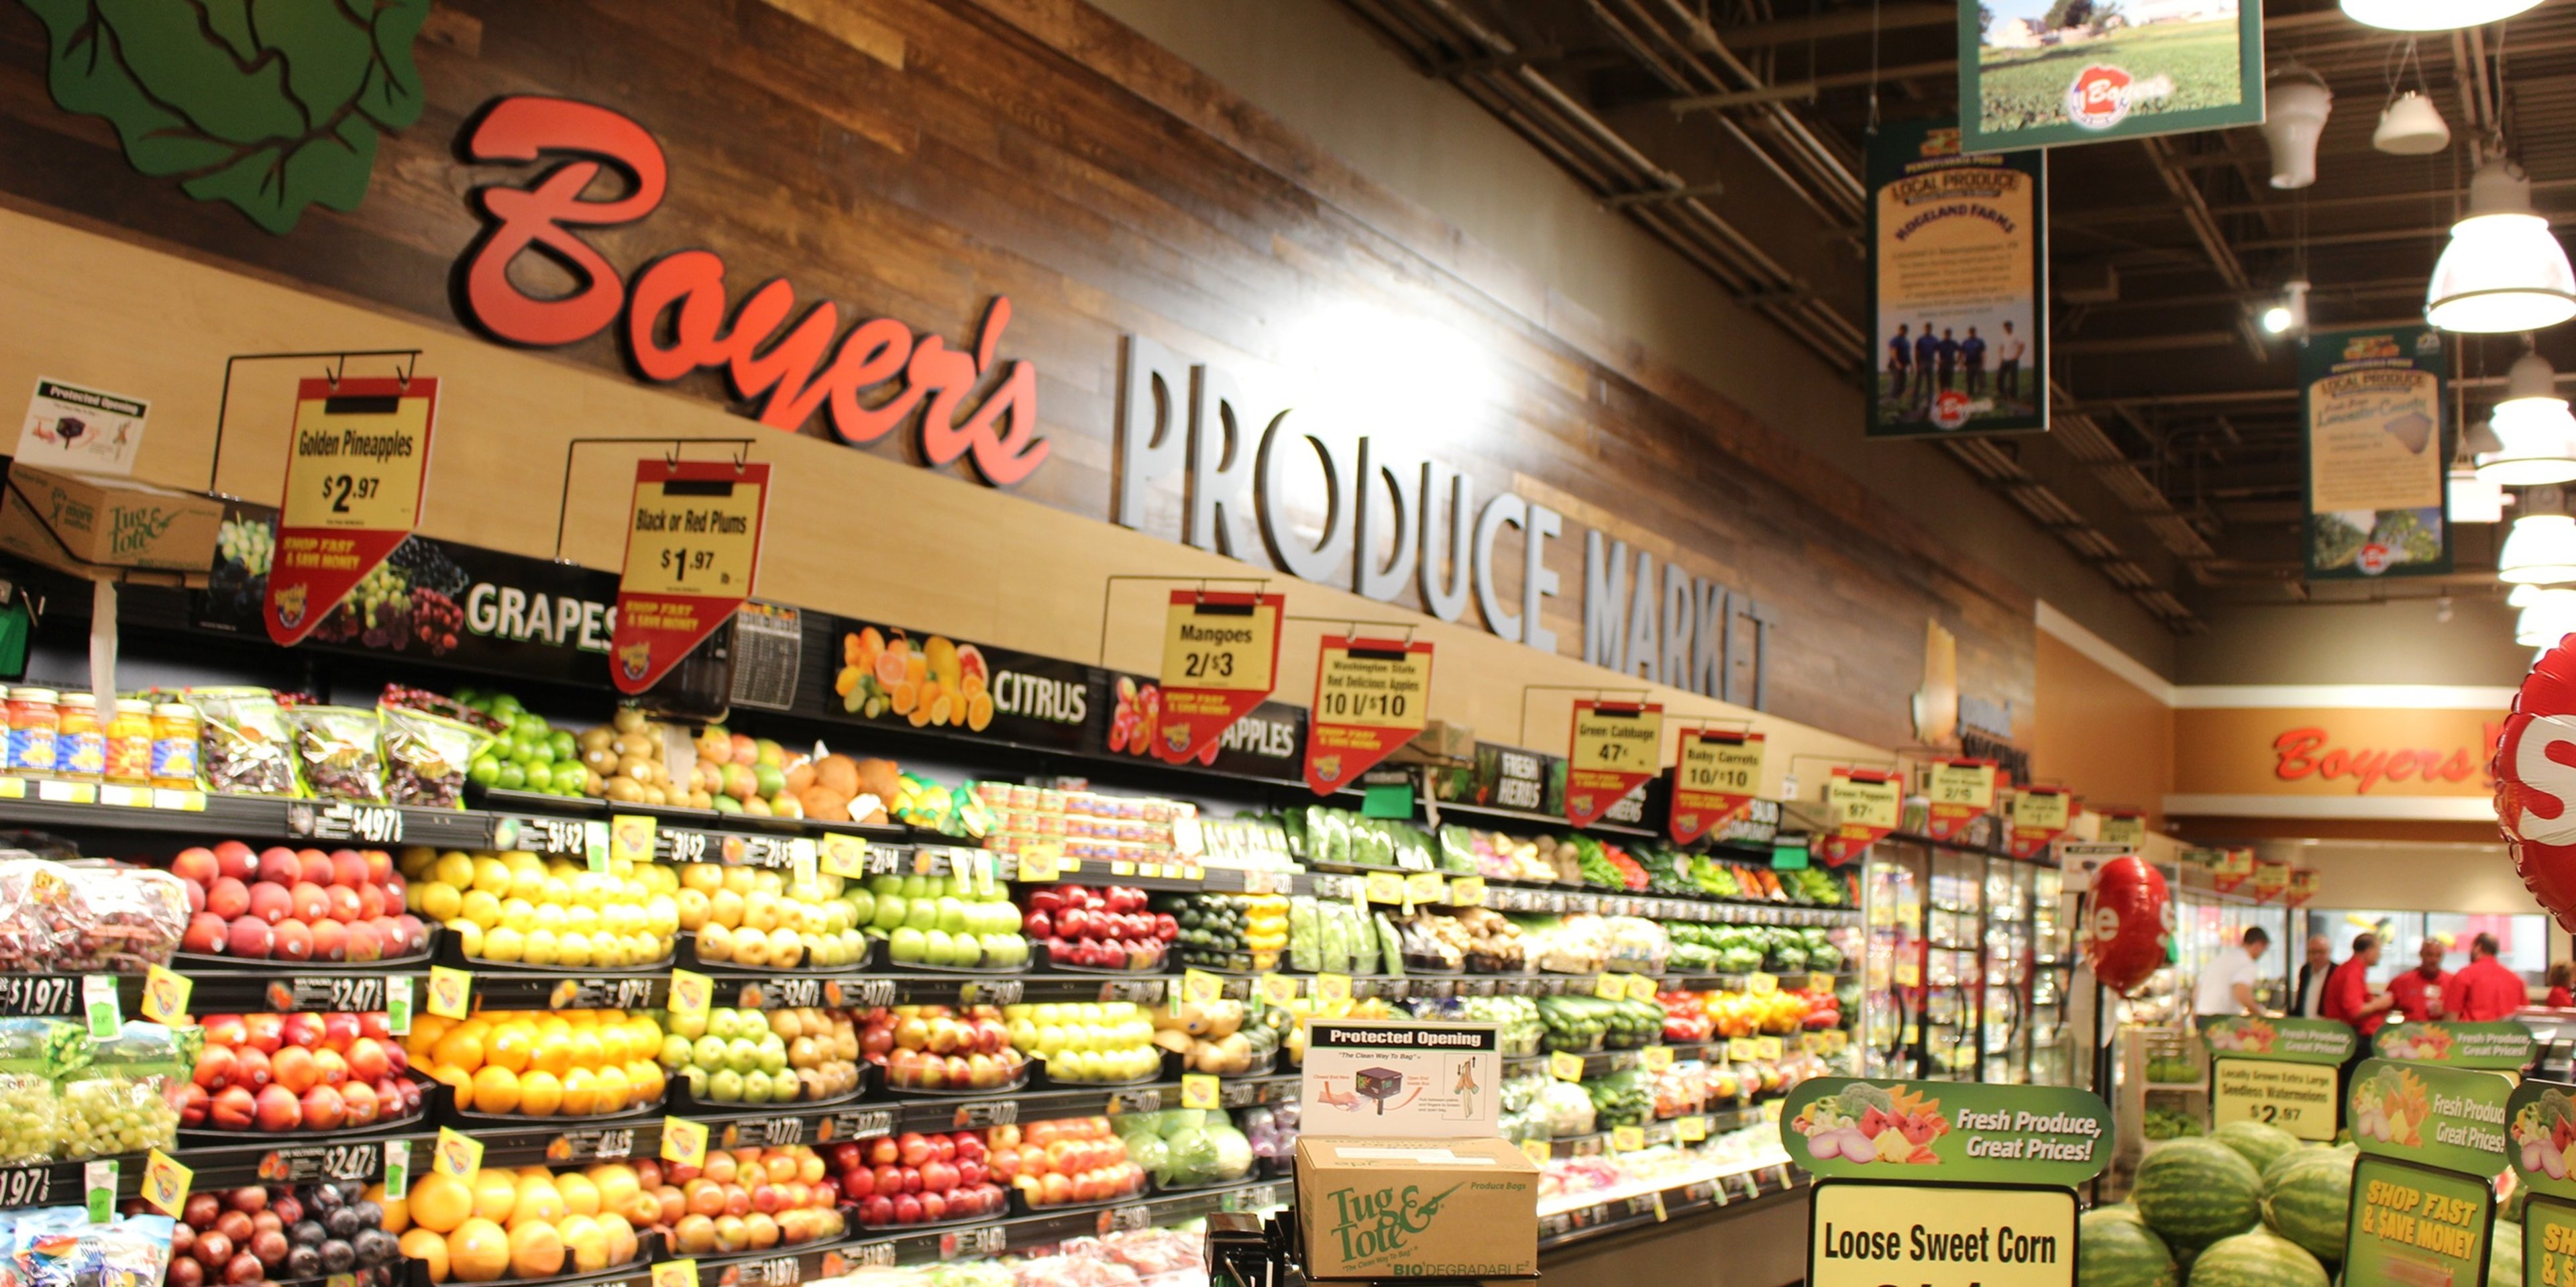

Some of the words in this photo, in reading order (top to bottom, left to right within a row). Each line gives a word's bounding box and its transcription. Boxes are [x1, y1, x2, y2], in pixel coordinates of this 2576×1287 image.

[1892, 176, 1937, 200] LOCAL
[1943, 170, 2019, 191] PRODUCE
[1970, 203, 2015, 234] FARMS
[462, 95, 1050, 486] Boyer's
[50, 386, 100, 406] Protected
[299, 430, 339, 456] Golden
[342, 429, 413, 463] Pineapples
[322, 472, 379, 513] $2.97
[1111, 333, 1563, 654] PRODUCE
[637, 509, 665, 532] Black
[669, 514, 682, 532] or
[685, 509, 707, 533] Red
[710, 511, 747, 535] Plums
[661, 548, 714, 582] $1.97
[466, 582, 617, 653] GRAPES
[1585, 529, 1779, 711] MARKET
[1180, 624, 1252, 646] Mangoes
[1185, 652, 1233, 678] 2/$3
[1334, 661, 1387, 674] Washington
[994, 670, 1087, 724] CITRUS
[1328, 674, 1343, 686] Red
[1346, 675, 1387, 689] Delicious
[1390, 680, 1419, 692] Apples
[1220, 715, 1295, 757] APPLES
[1580, 724, 1608, 736] Green
[1611, 725, 1655, 742] Cabbage
[1501, 751, 1539, 781] FRESH
[1687, 749, 1714, 764] Baby
[1719, 751, 1759, 766] Carrots
[1497, 776, 1542, 809] HERBS
[9, 978, 66, 1015] $1.97
[331, 978, 376, 1012] $2.47
[1330, 1029, 1413, 1045] Protected
[1417, 1031, 1481, 1047] Opening
[2281, 1027, 2308, 1040] Fresh
[2285, 1041, 2314, 1052] Great
[2457, 1033, 2485, 1043] Fresh
[1375, 1053, 1390, 1062] Way
[2463, 1045, 2491, 1056] Great
[2492, 1045, 2528, 1057] Prices!
[2222, 1083, 2263, 1097] Seedless
[2266, 1086, 2328, 1103] Watermelons
[1956, 1108, 2010, 1133] Fresh
[2015, 1109, 2102, 1139] Produce,
[2433, 1093, 2462, 1117] Fresh
[2464, 1098, 2505, 1125] Produc
[1966, 1136, 2023, 1160] Great
[2025, 1138, 2094, 1162] Prices!
[2436, 1121, 2467, 1146] Great
[2469, 1129, 2505, 1153] Prices!
[0, 1168, 42, 1206] 1.97
[1470, 1182, 1505, 1190] Produce
[1506, 1182, 1527, 1190] Bags
[1328, 1186, 1399, 1229] Tug
[2366, 1179, 2421, 1213] SHOP
[2421, 1191, 2479, 1227] FAST
[1330, 1223, 1408, 1263] Tote
[1825, 1222, 1901, 1261] Loose
[1910, 1224, 1989, 1262] Sweet
[1997, 1226, 2056, 1264] Corn
[2362, 1204, 2375, 1234] &
[2416, 1219, 2477, 1260] MONEY
[2543, 1223, 2576, 1257] SH
